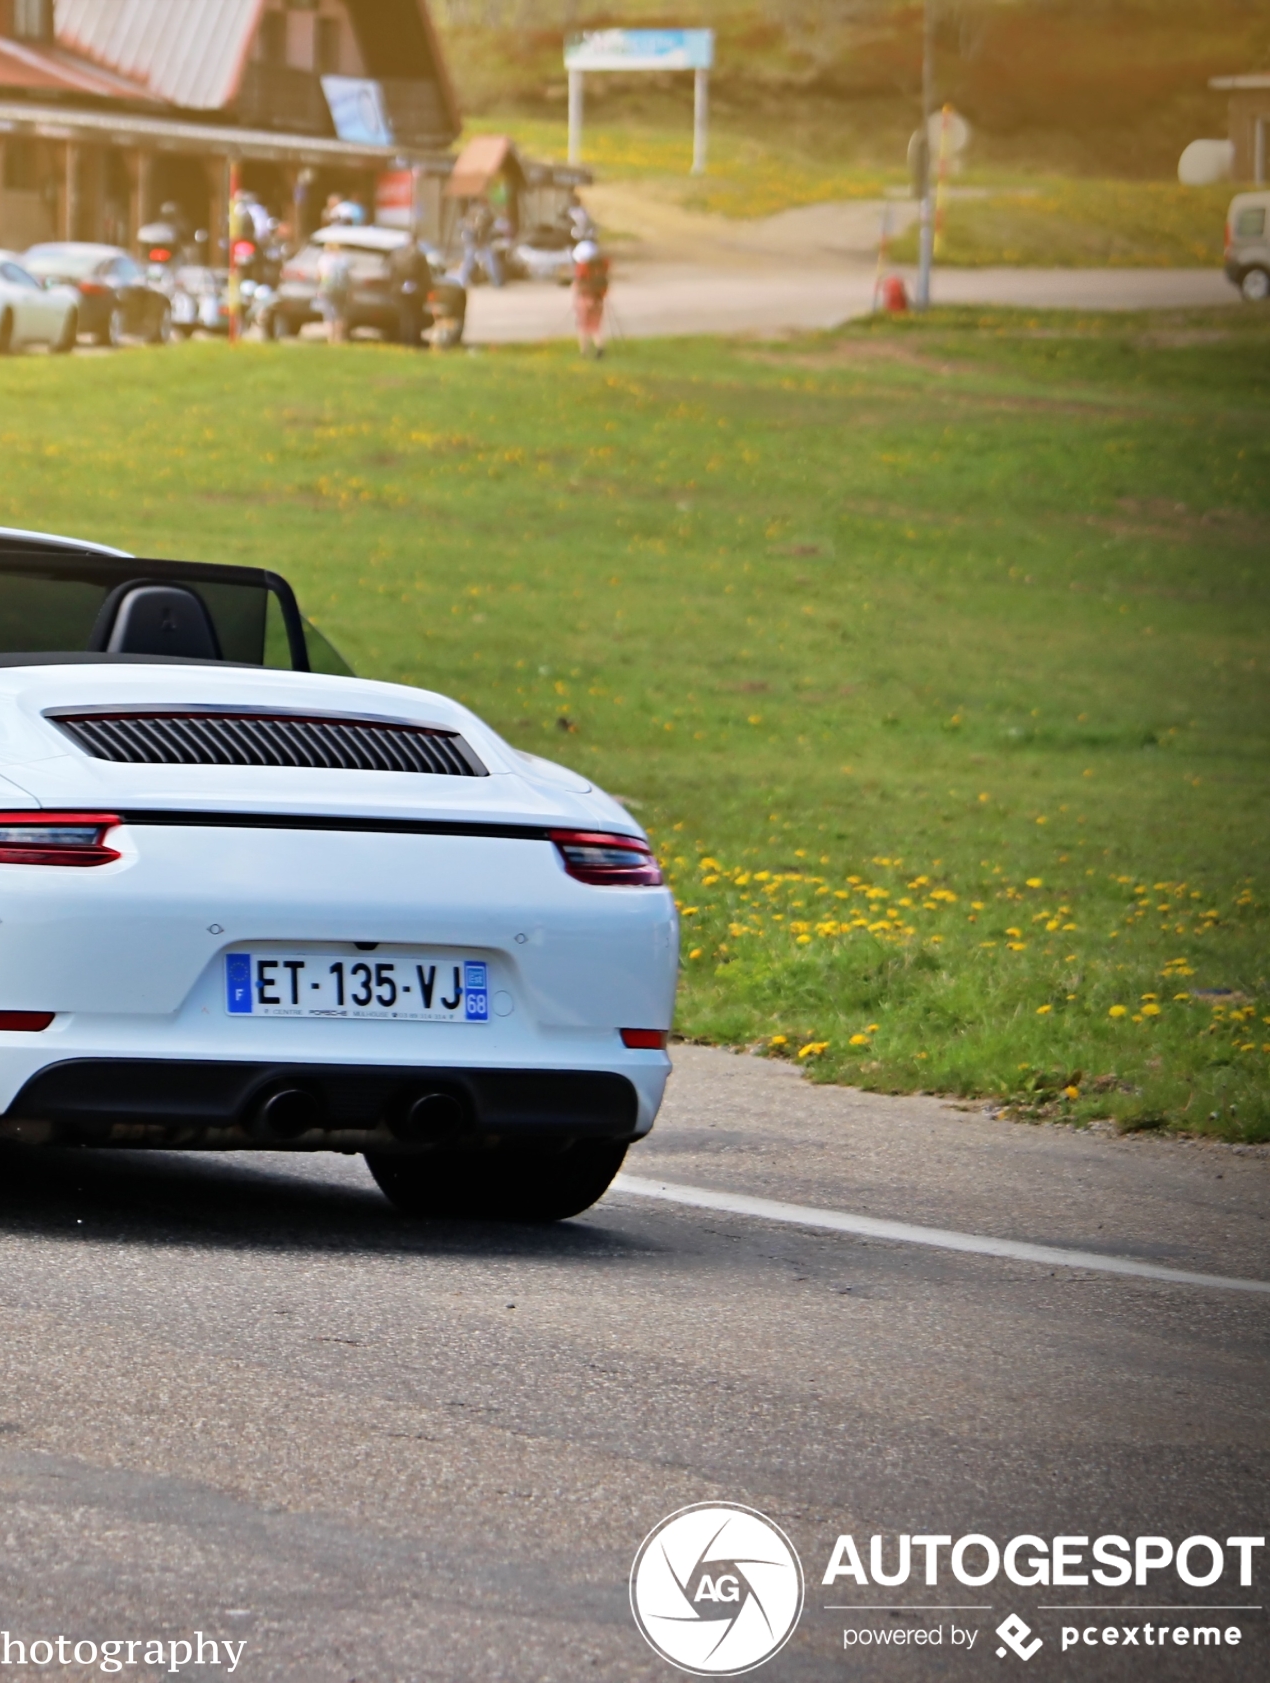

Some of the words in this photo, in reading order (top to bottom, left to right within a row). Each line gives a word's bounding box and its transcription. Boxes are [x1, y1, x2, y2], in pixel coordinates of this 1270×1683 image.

[257, 960, 463, 1010] ET-135-VJ
[235, 988, 244, 1001] F
[467, 994, 486, 1014] 68
[309, 1009, 348, 1017] PORSCHE
